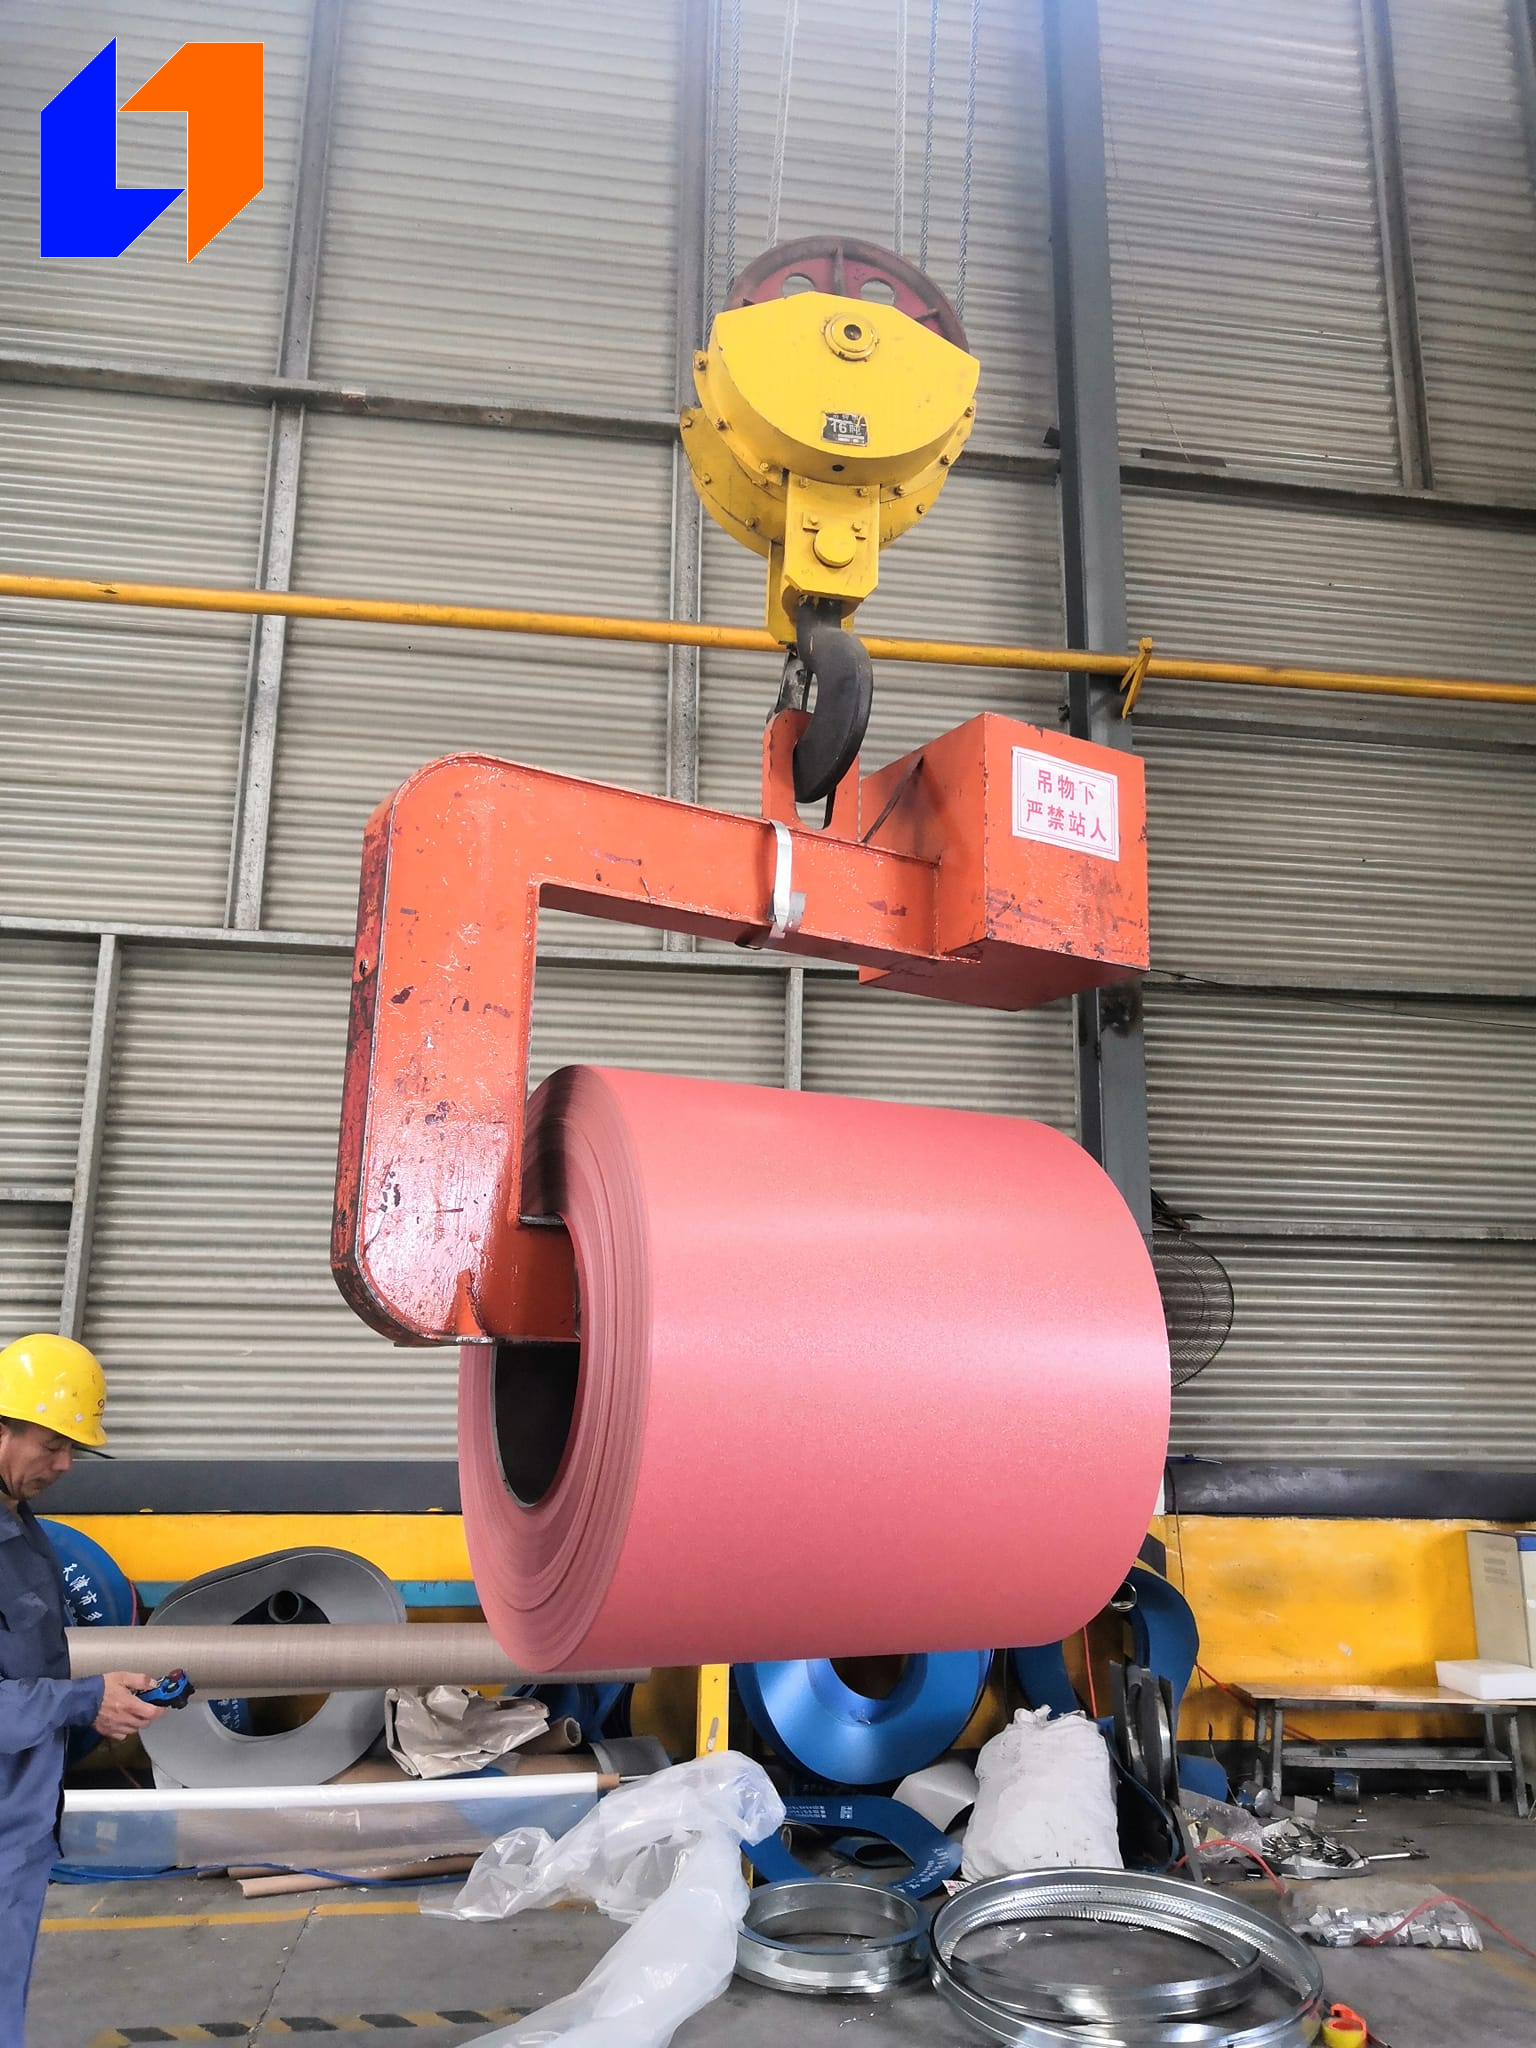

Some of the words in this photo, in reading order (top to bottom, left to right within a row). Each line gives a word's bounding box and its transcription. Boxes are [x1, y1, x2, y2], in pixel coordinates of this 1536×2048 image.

[1037, 768, 1097, 805] 吊物下
[1026, 799, 1108, 842] 严禁站人
